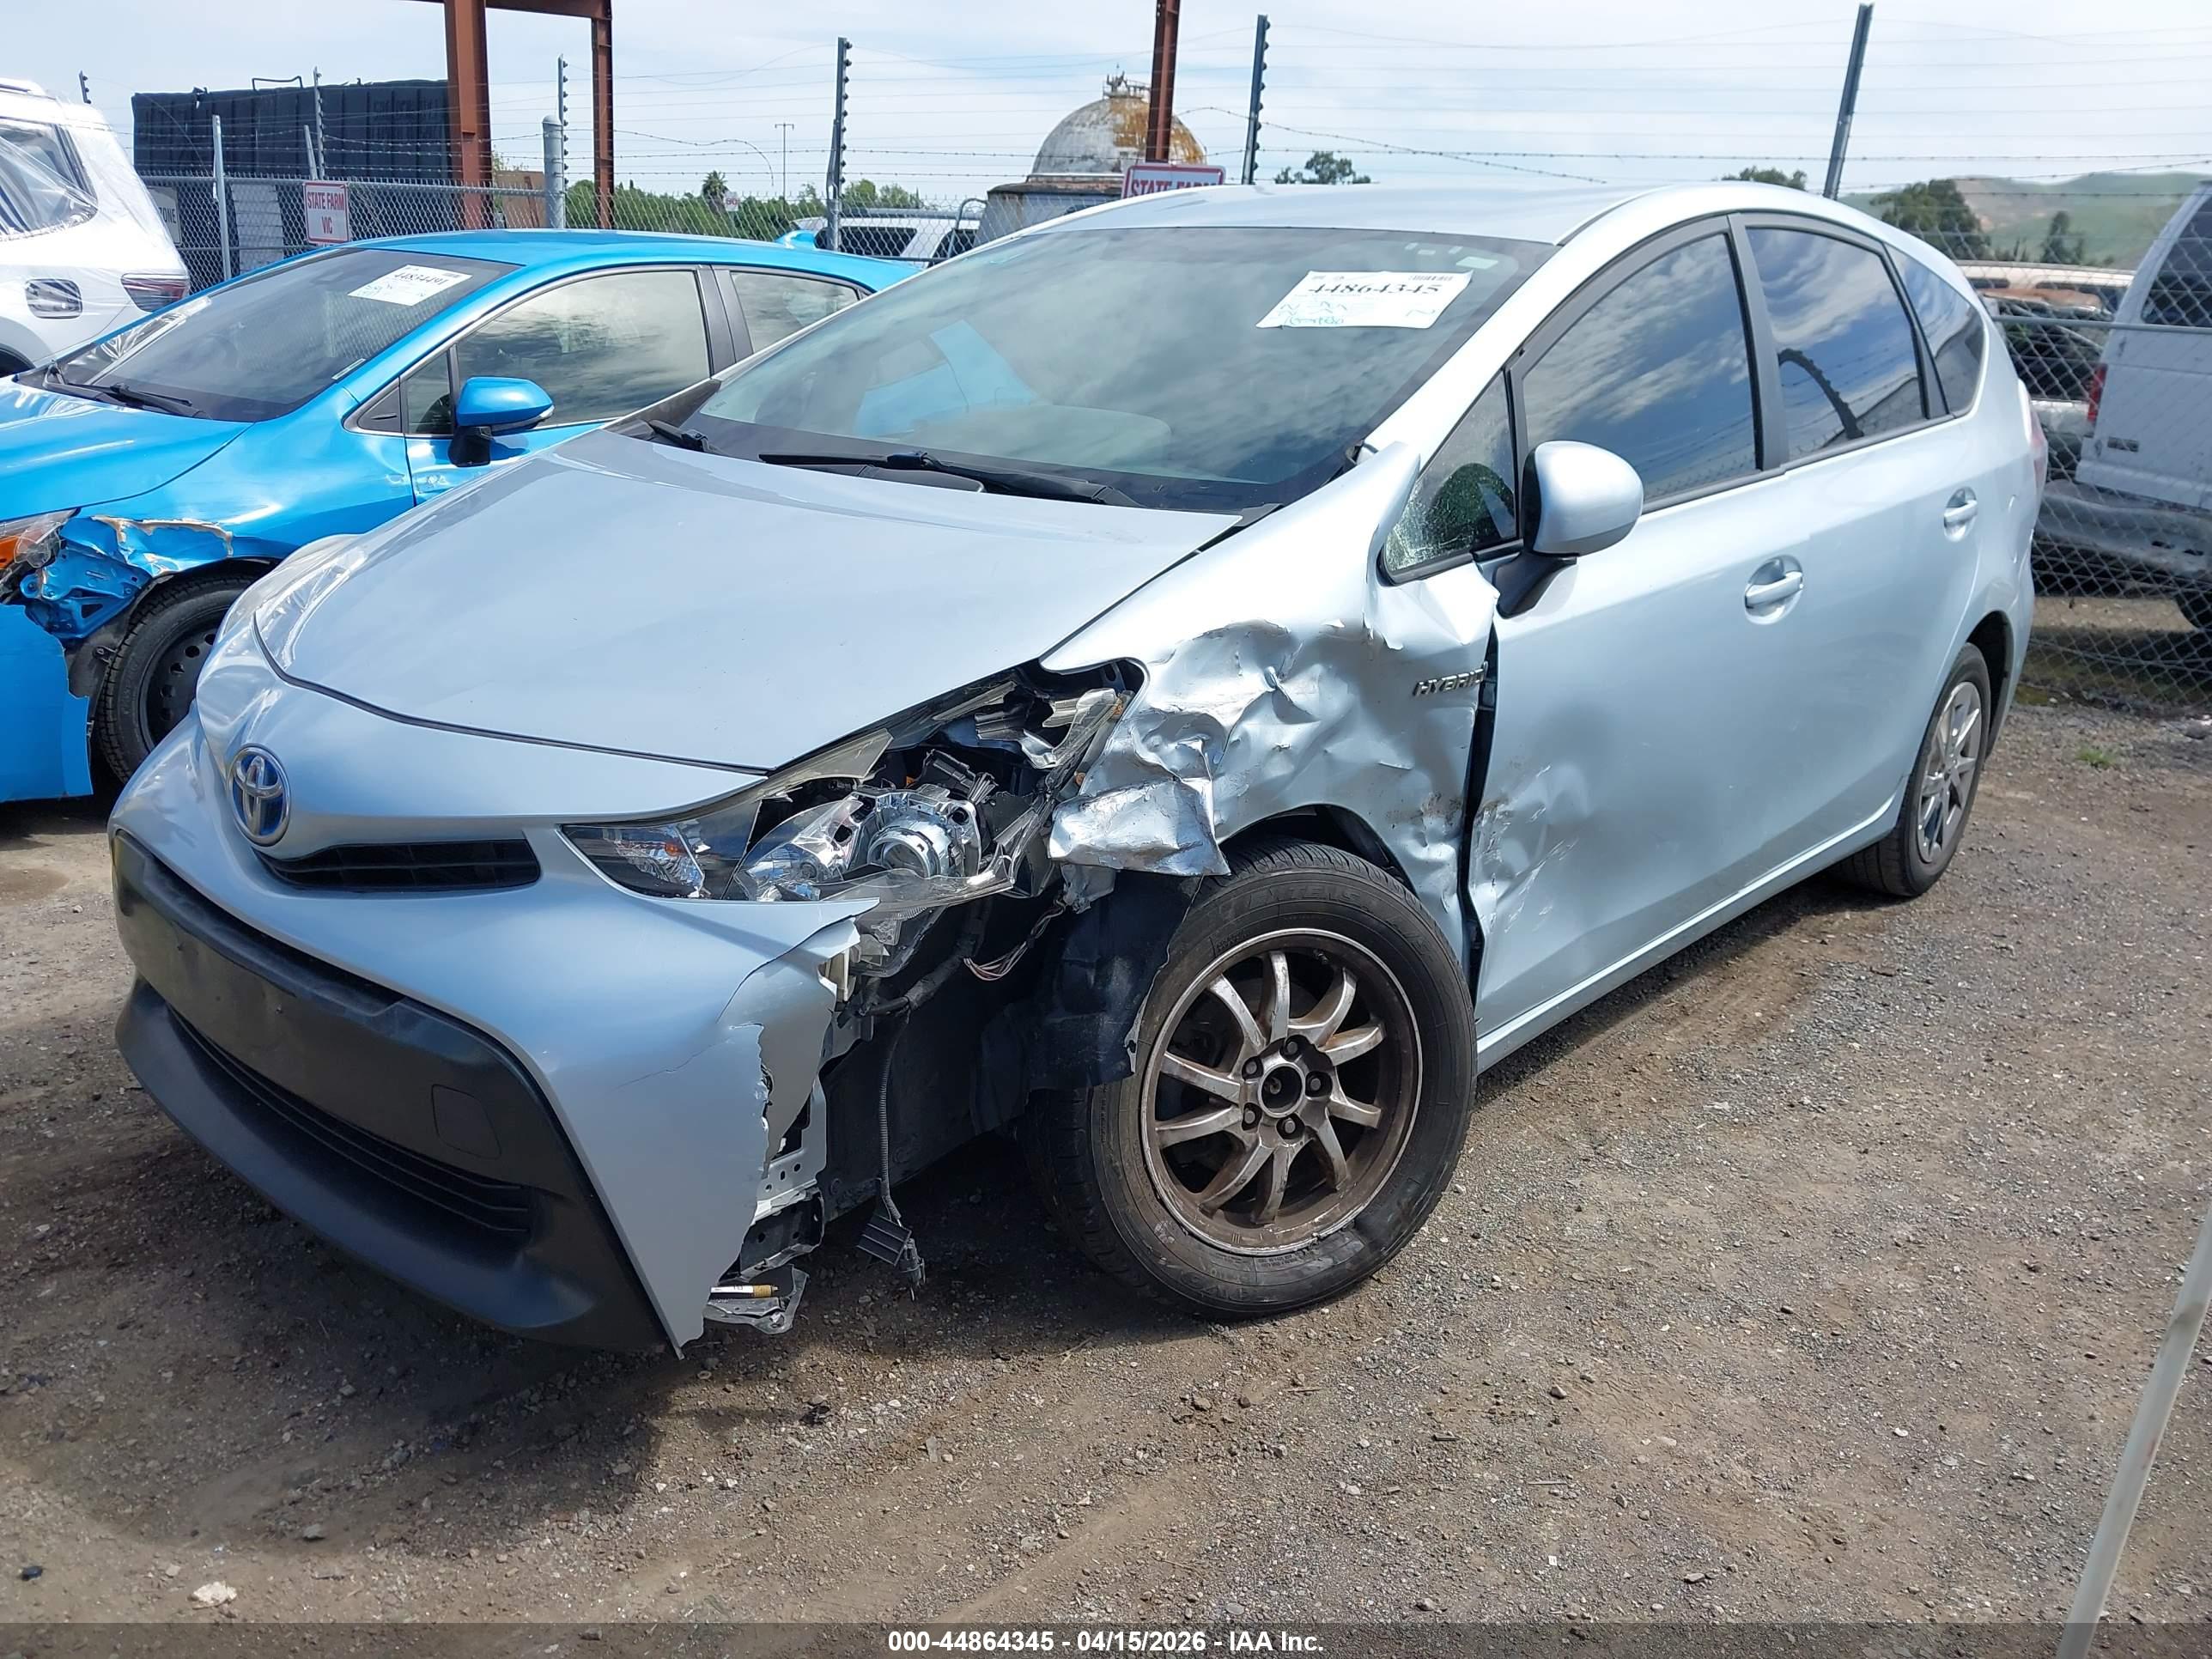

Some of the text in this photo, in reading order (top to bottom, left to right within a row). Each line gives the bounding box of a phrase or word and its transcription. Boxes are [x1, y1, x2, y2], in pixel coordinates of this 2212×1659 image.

[307, 191, 344, 210] STATE FARM
[322, 216, 333, 234] VIC
[1308, 283, 1443, 294] 44864345
